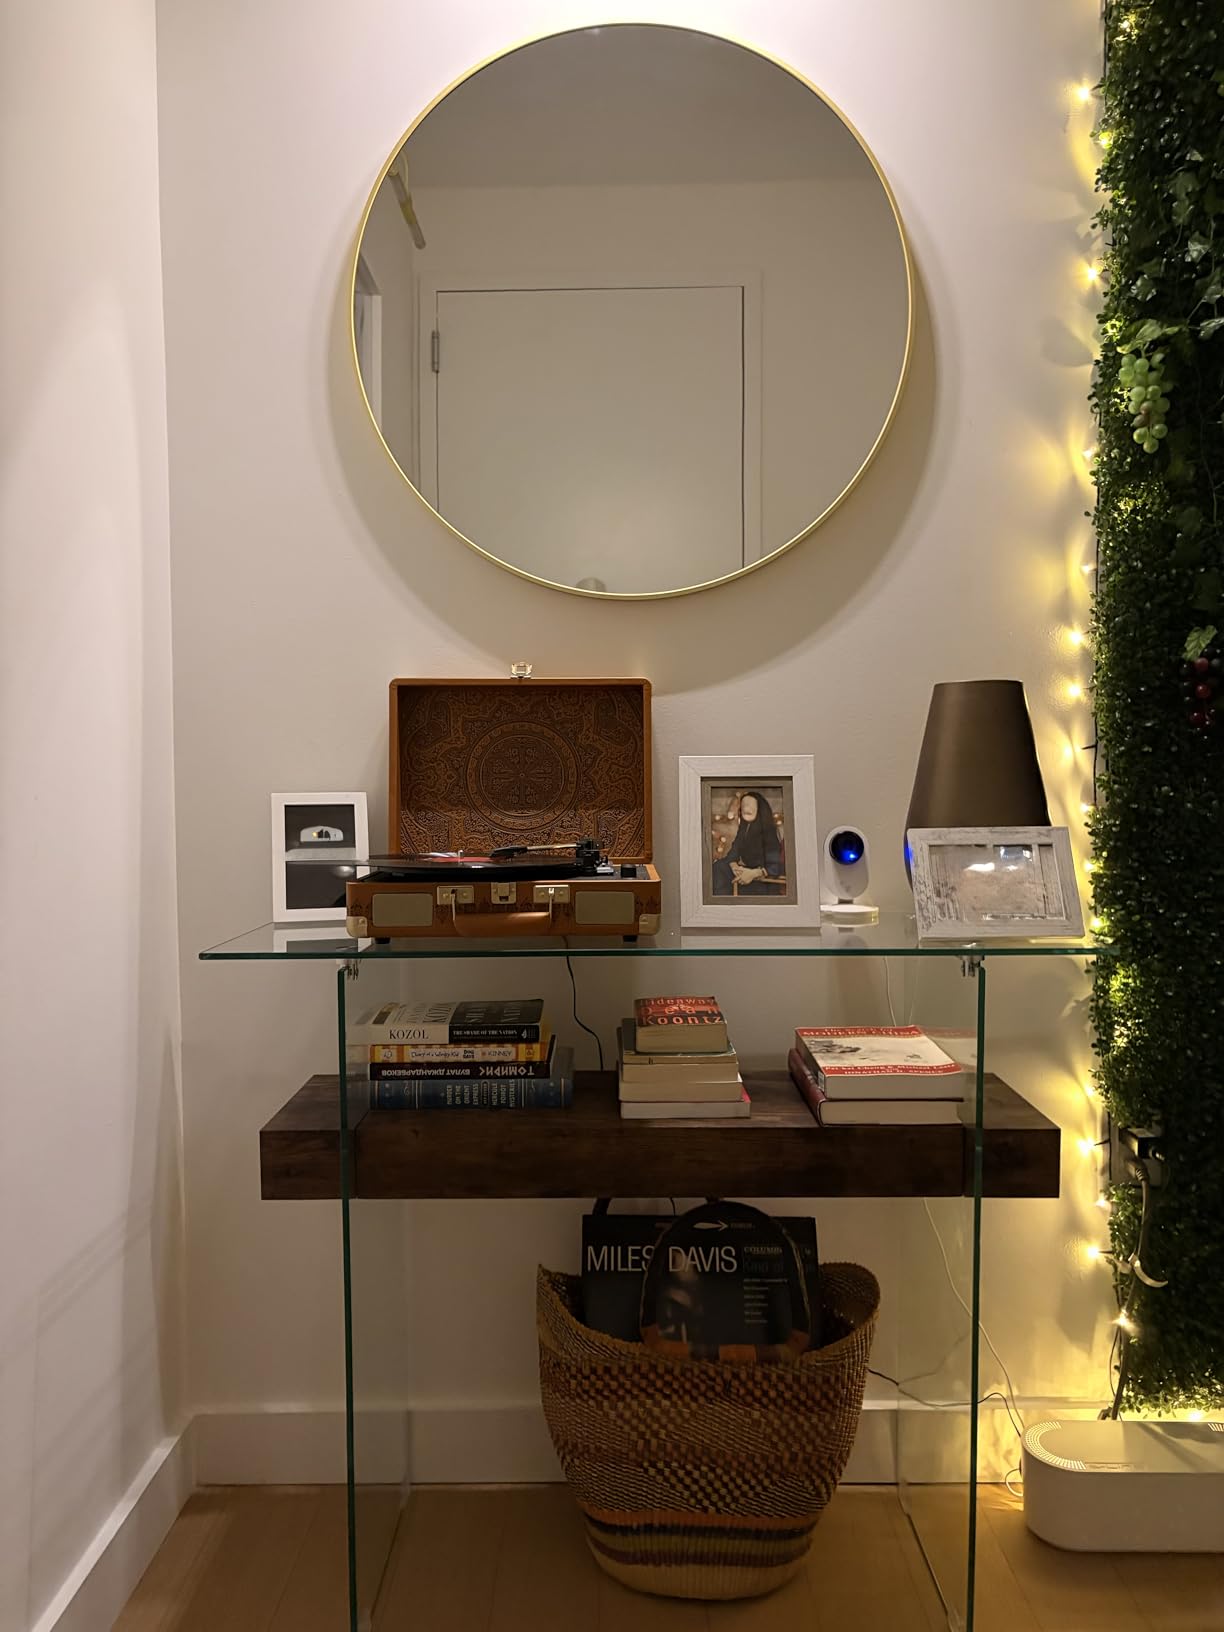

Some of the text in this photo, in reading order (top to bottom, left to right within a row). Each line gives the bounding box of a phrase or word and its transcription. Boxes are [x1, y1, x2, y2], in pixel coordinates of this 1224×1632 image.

[640, 1005, 718, 1016] Dean
[642, 1015, 724, 1026] Koontz
[389, 1029, 430, 1040] KOZOL
[446, 1068, 471, 1076] БУЛАТ
[479, 1066, 535, 1076] ТОМИРИС
[587, 1245, 738, 1273] MILES DAVIS
